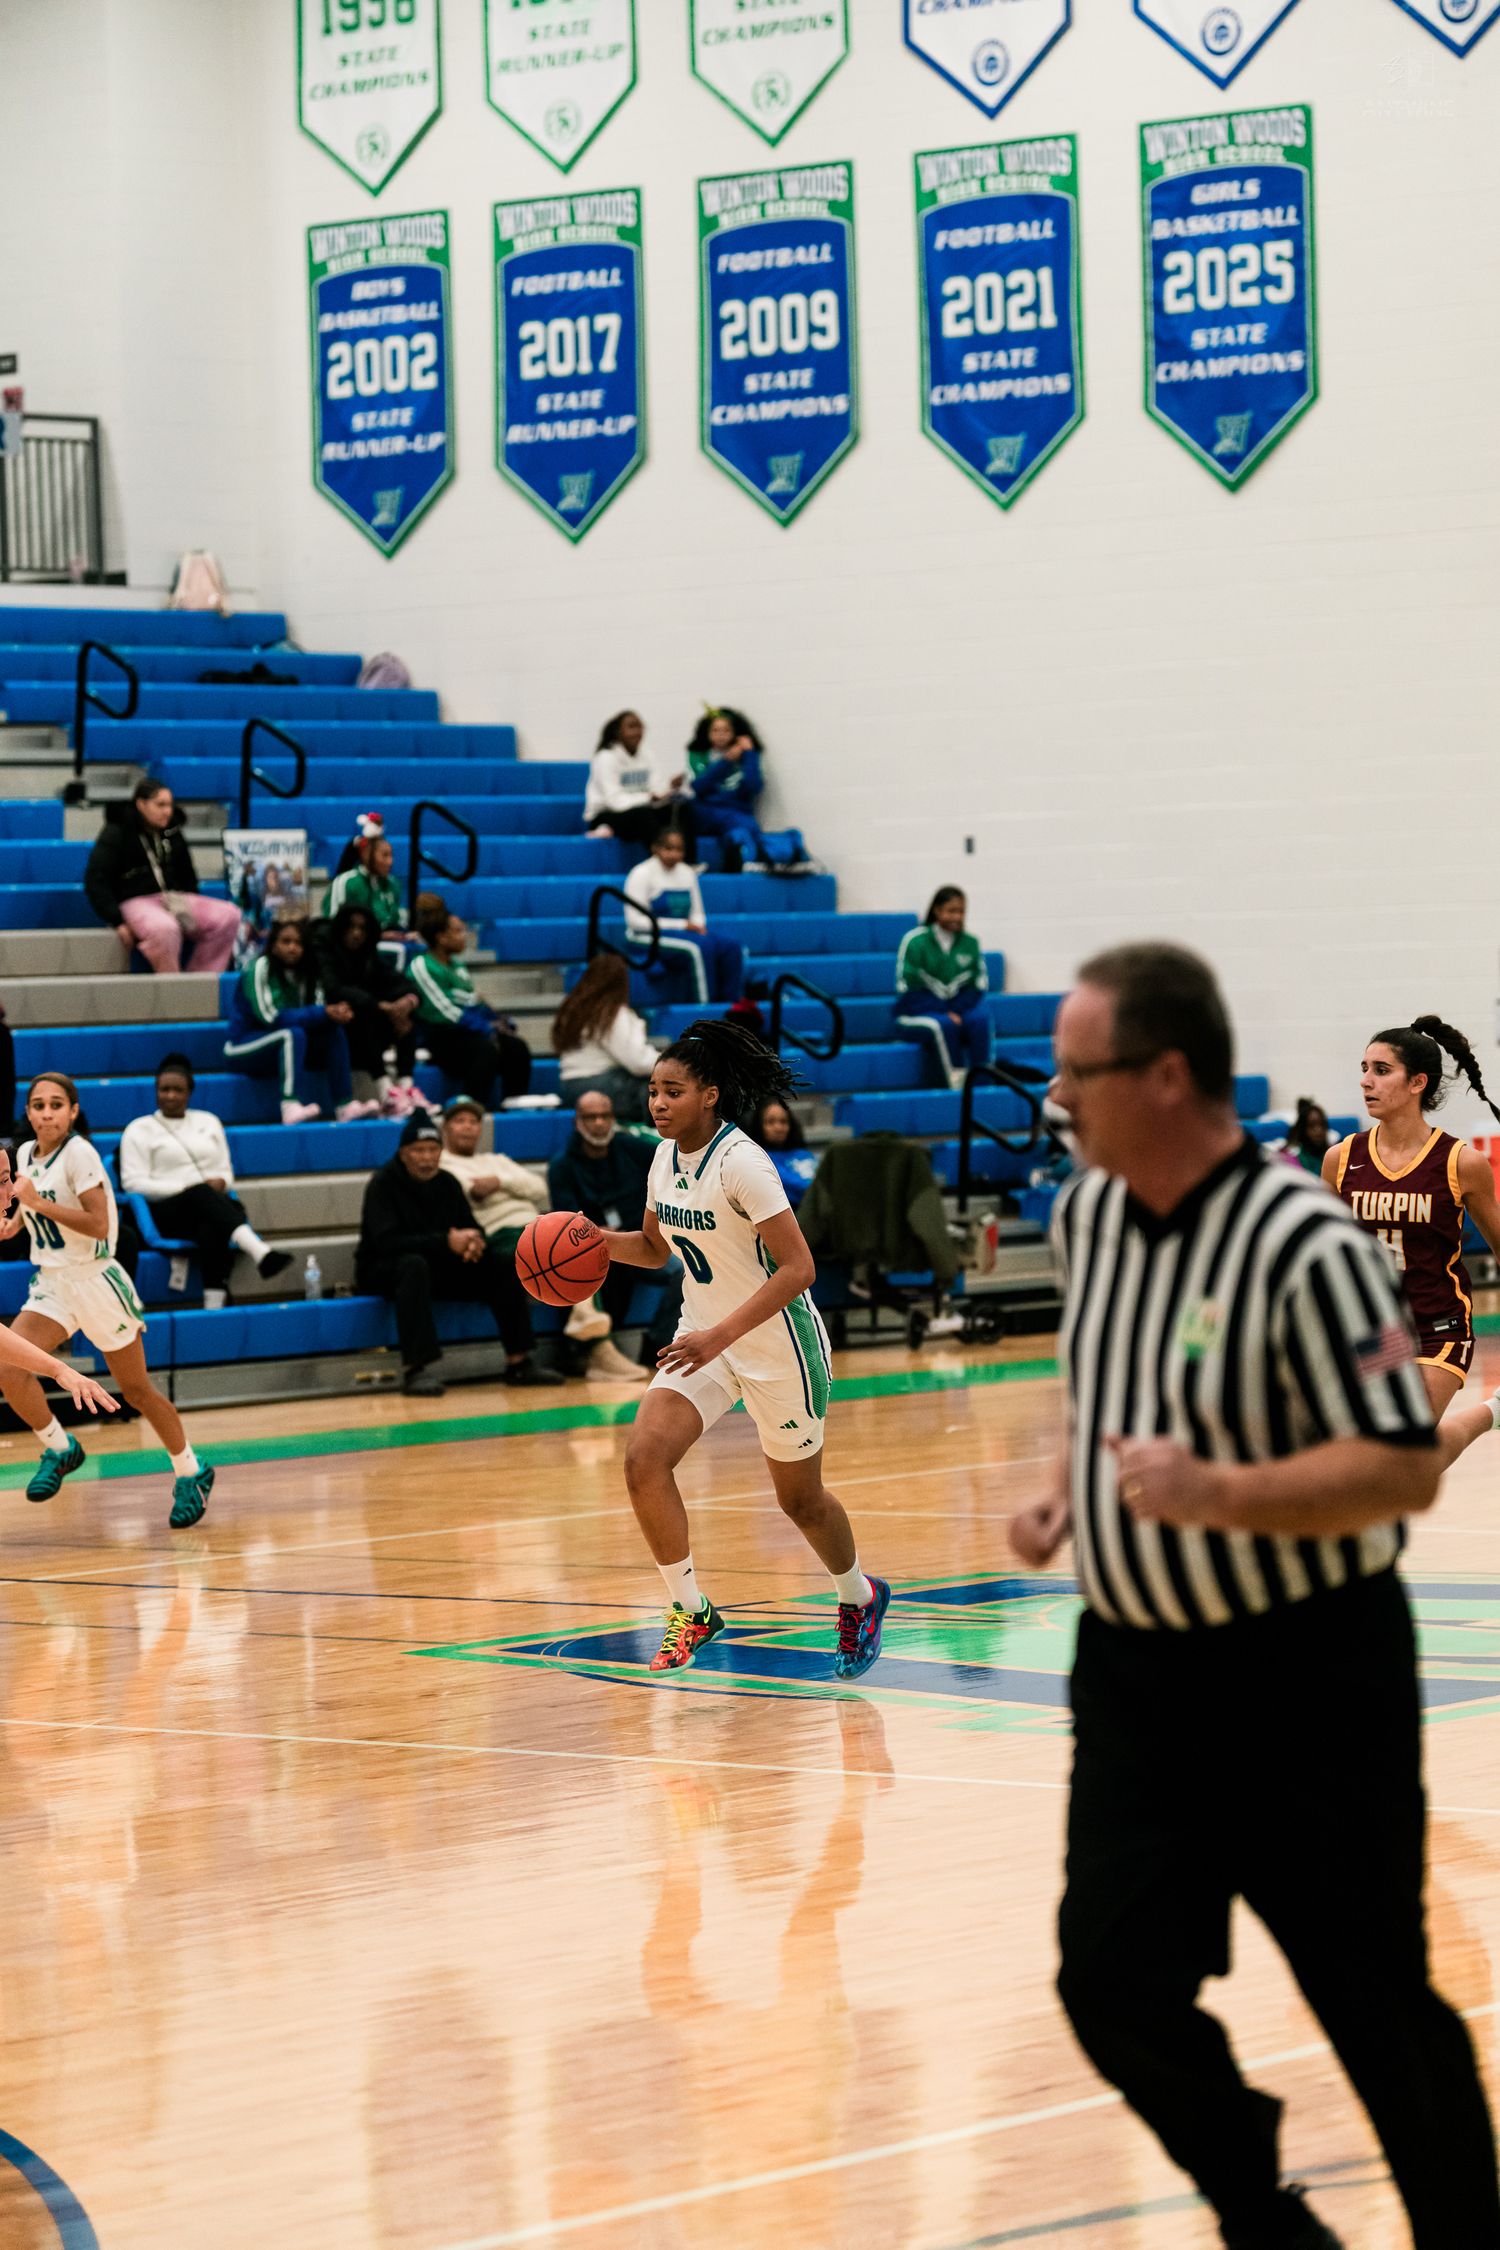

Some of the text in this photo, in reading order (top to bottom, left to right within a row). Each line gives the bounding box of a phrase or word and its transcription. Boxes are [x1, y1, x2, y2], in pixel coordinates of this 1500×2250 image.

[529, 19, 590, 40] STATE
[702, 12, 833, 46] CHAMPIONS
[338, 45, 399, 68] STATE
[497, 42, 625, 73] RUNNER-UP
[1143, 108, 1306, 165] WINTON WOODS
[1001, 137, 1072, 176] WOODS
[1190, 178, 1261, 205] GIRLS
[934, 217, 1056, 251] FOOTBALL
[1151, 205, 1300, 240] BASKETBALL
[717, 242, 834, 273] FOOTBALL
[511, 267, 624, 297] FOOTBALL
[1163, 239, 1295, 314] 2025
[318, 300, 440, 333] BASKETBALL
[941, 266, 1058, 338] 2021
[719, 289, 840, 360] 2009
[1190, 322, 1268, 350] STATE
[519, 313, 622, 381] 2017
[962, 347, 1038, 373] STATE
[327, 331, 439, 399] 2002
[744, 368, 814, 394] STATE
[1156, 350, 1305, 384] CHAMPIONS
[536, 388, 605, 414] STATE
[930, 373, 1071, 405] CHAMPIONS
[351, 406, 414, 432] STATE
[711, 393, 849, 426] CHAMPIONS
[506, 414, 638, 444] RUNNER-UP
[322, 431, 447, 461] RUNNER-UP
[1351, 1190, 1432, 1223] TURPIN
[25, 1211, 65, 1250] 10
[672, 1234, 713, 1284] 0
[1460, 1340, 1472, 1365] T
